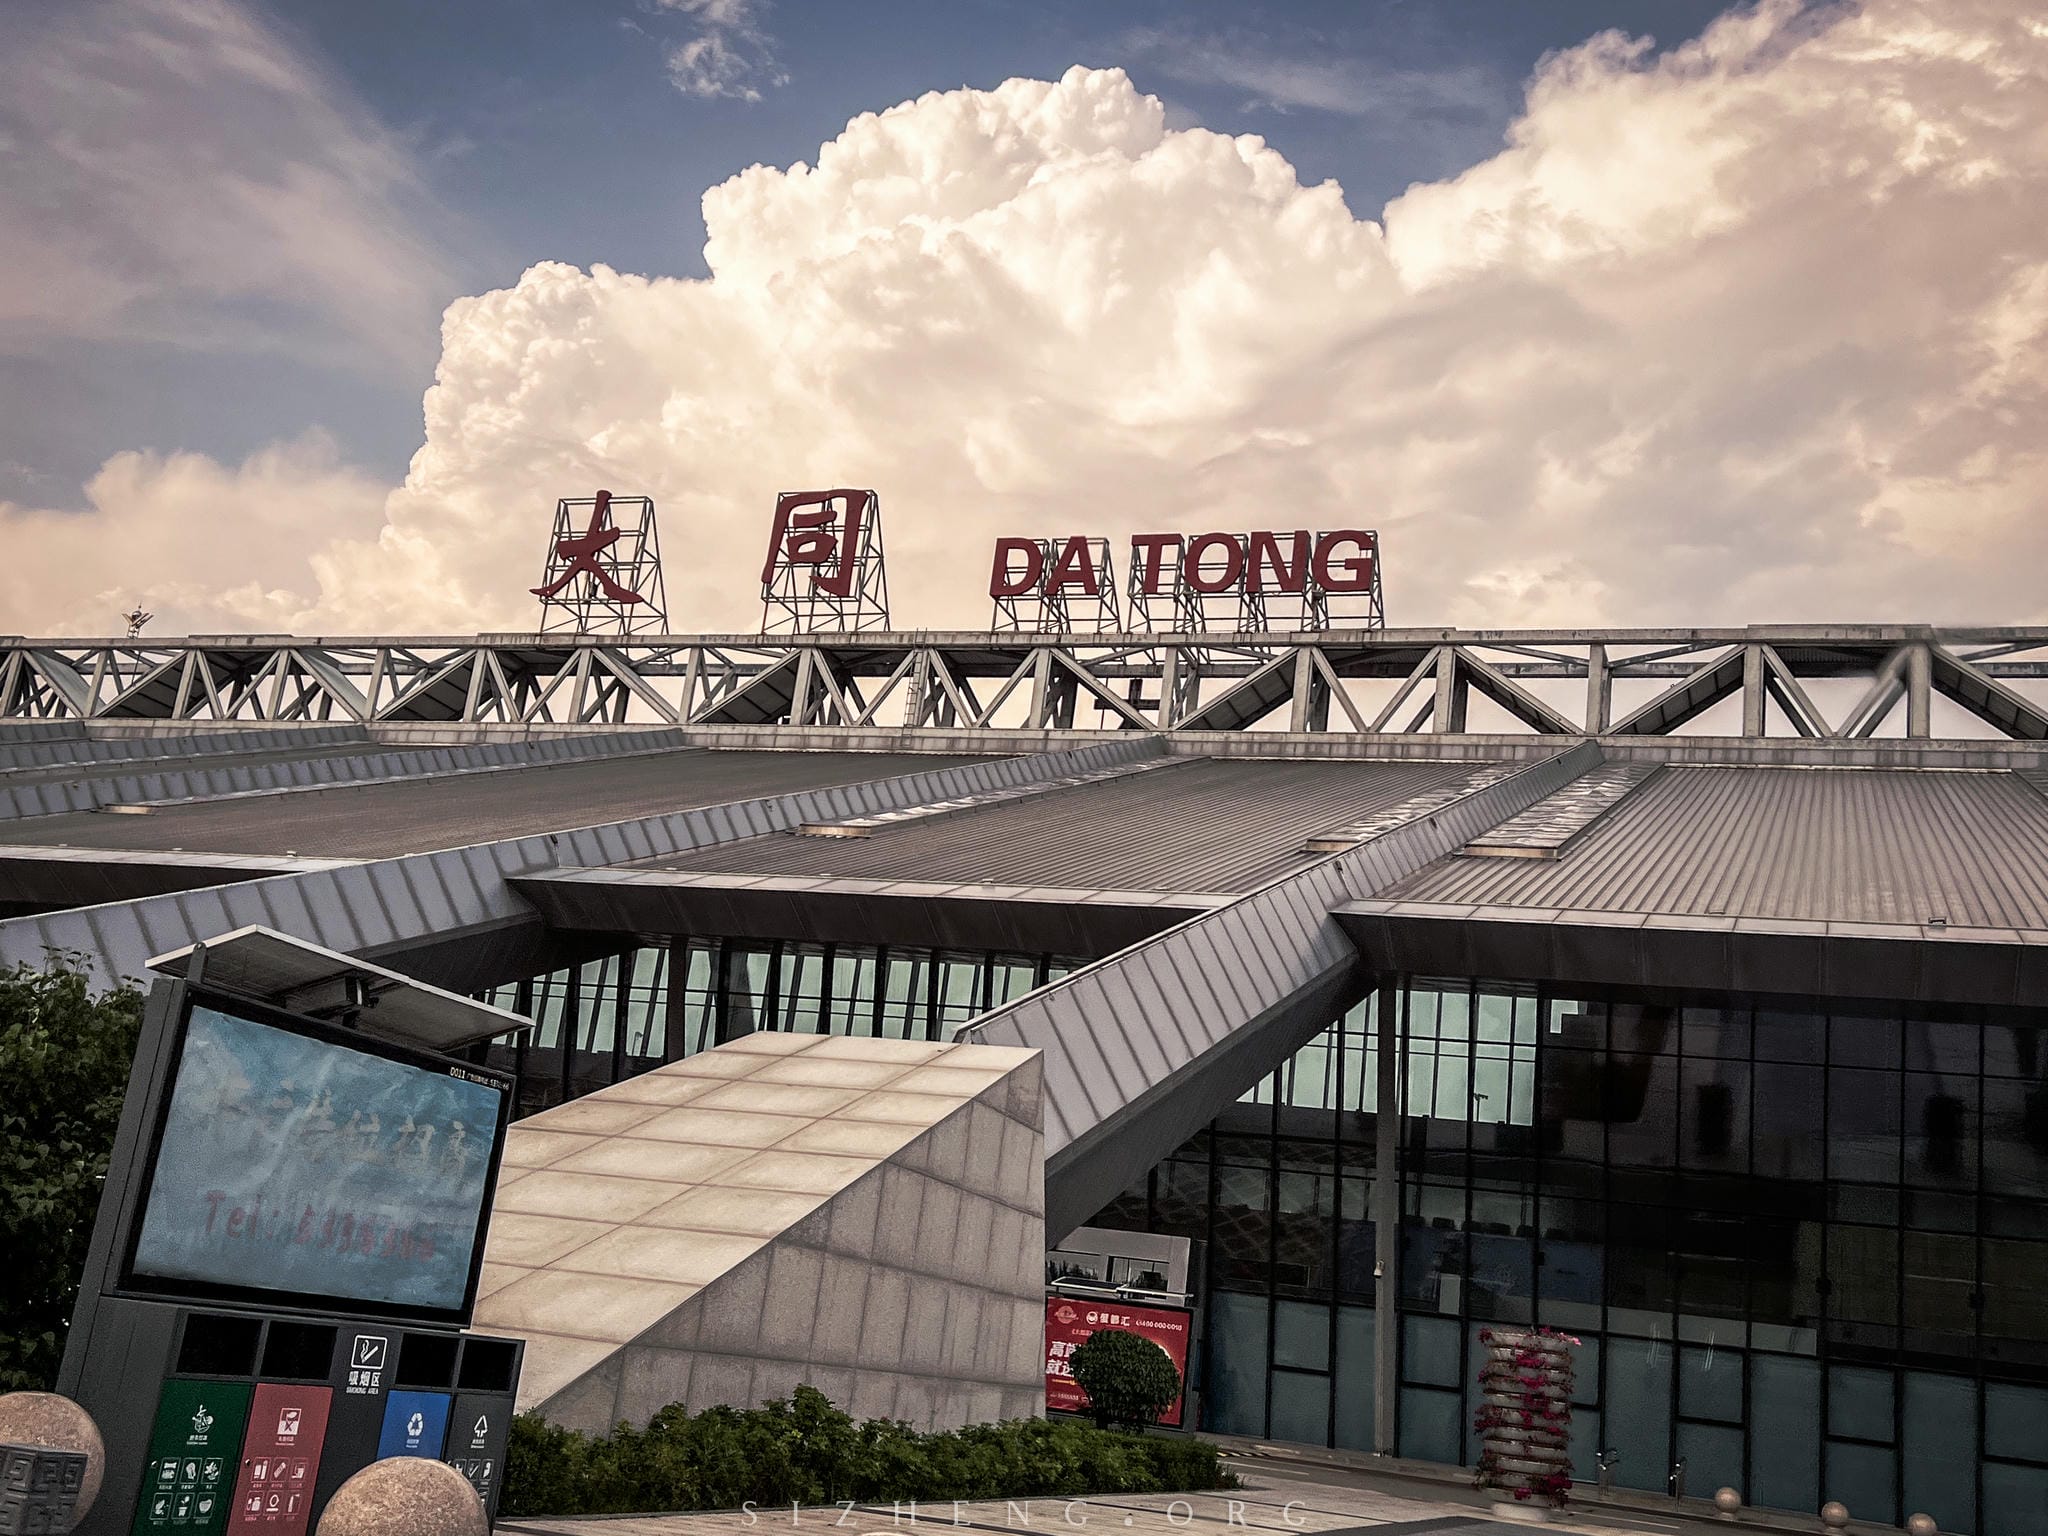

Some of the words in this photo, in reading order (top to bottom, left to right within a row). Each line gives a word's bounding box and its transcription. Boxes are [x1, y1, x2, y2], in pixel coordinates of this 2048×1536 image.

[529, 489, 871, 603] 大同
[989, 536, 1100, 596] DA
[1131, 529, 1374, 593] TONG
[349, 1371, 381, 1387] 吸烟区
